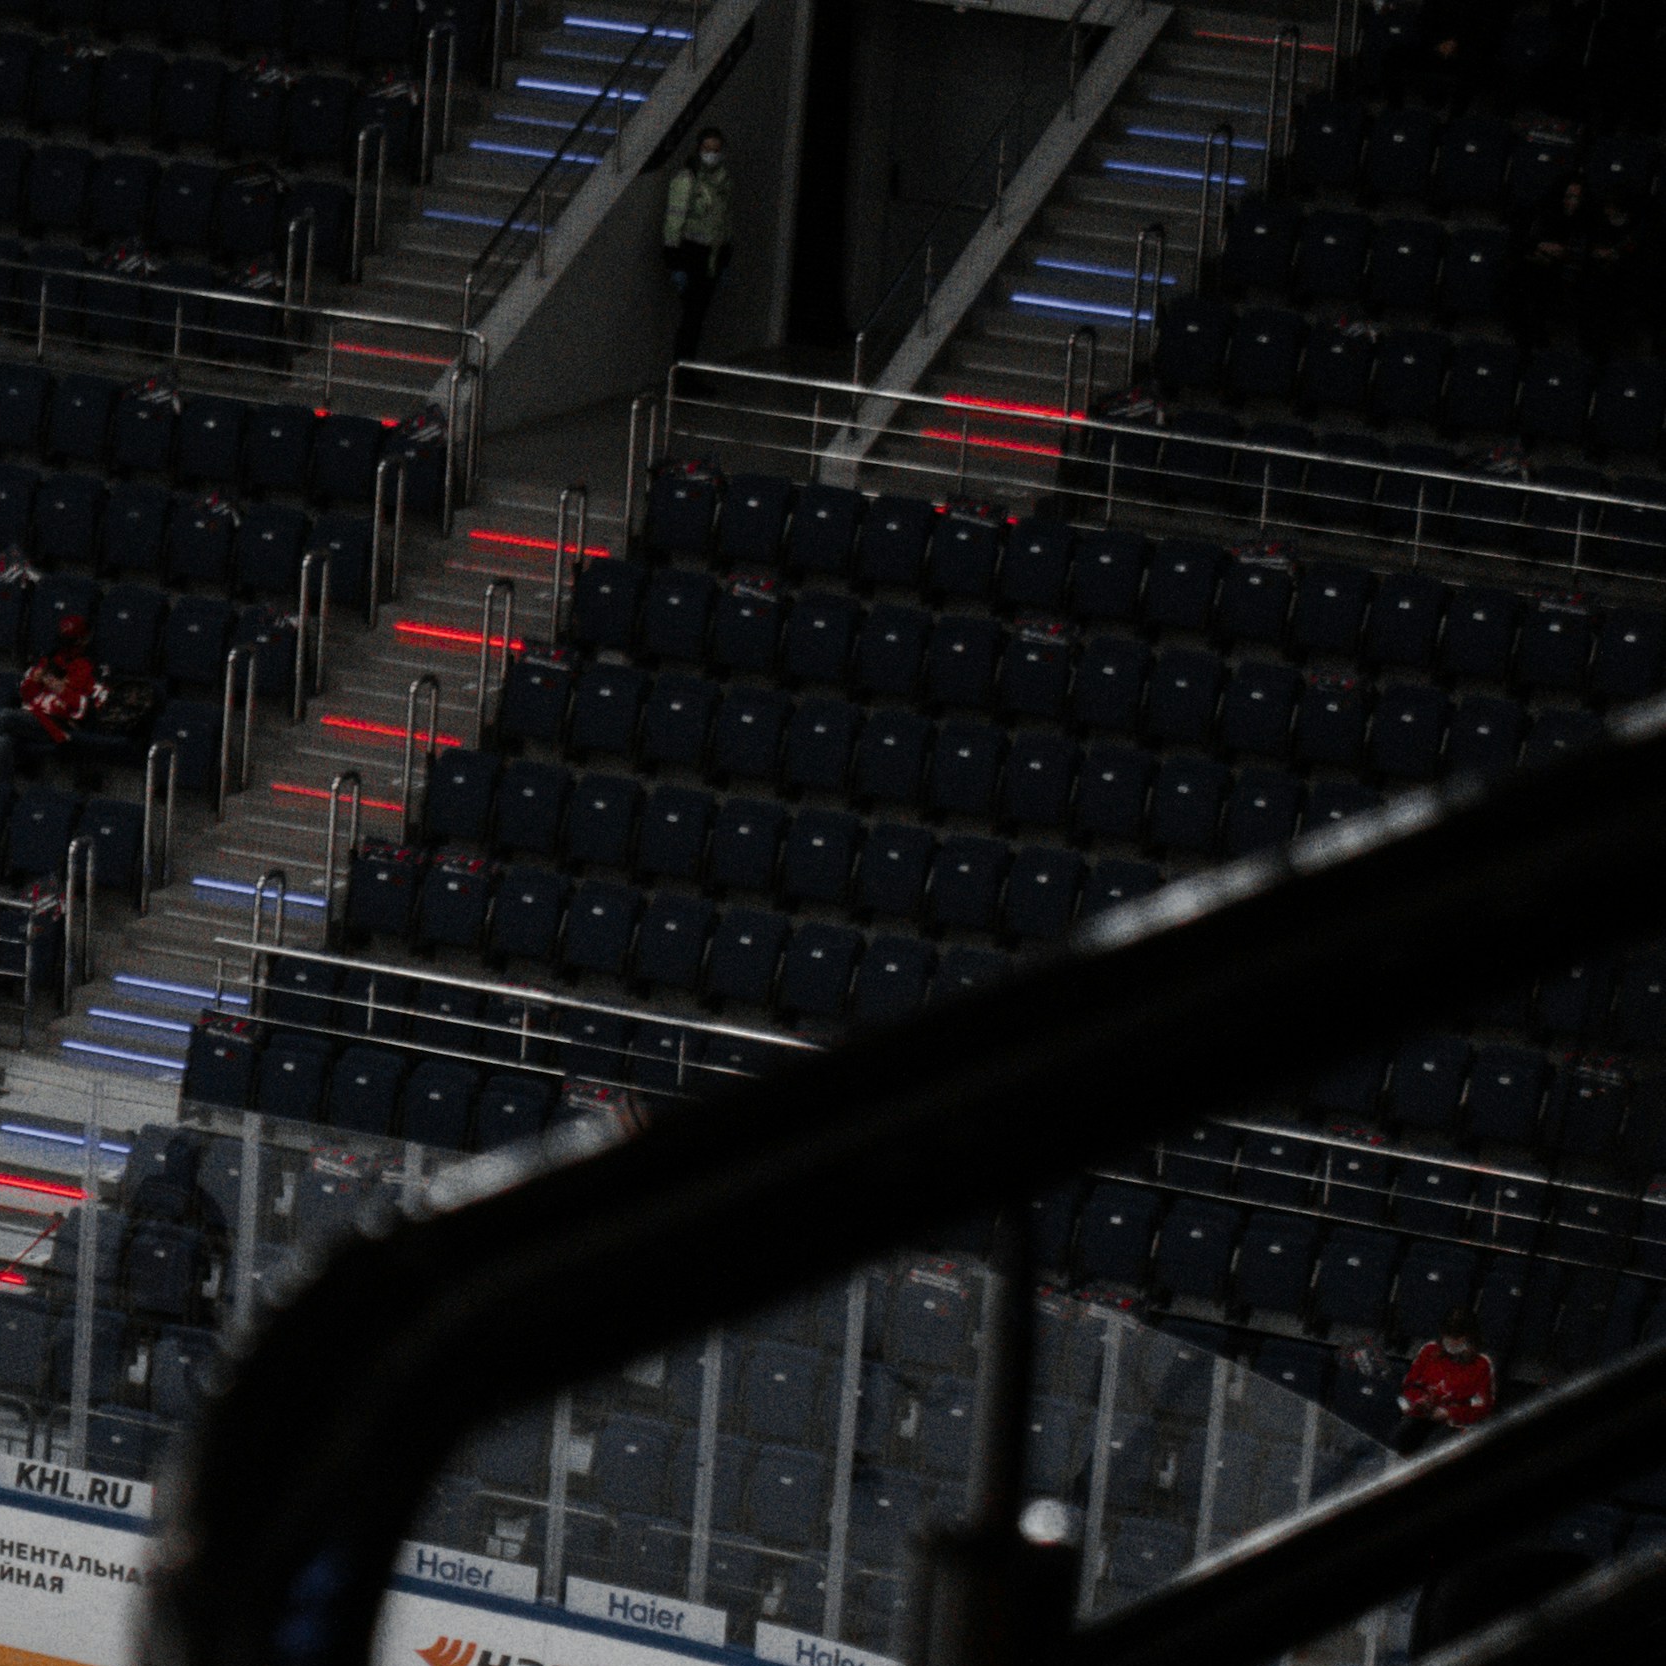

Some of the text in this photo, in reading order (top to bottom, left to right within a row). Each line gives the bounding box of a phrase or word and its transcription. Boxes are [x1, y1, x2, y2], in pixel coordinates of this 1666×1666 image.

[15, 1462, 133, 1509] KHL.RU
[417, 1549, 493, 1589] Haier
[609, 1593, 686, 1633] Haier
